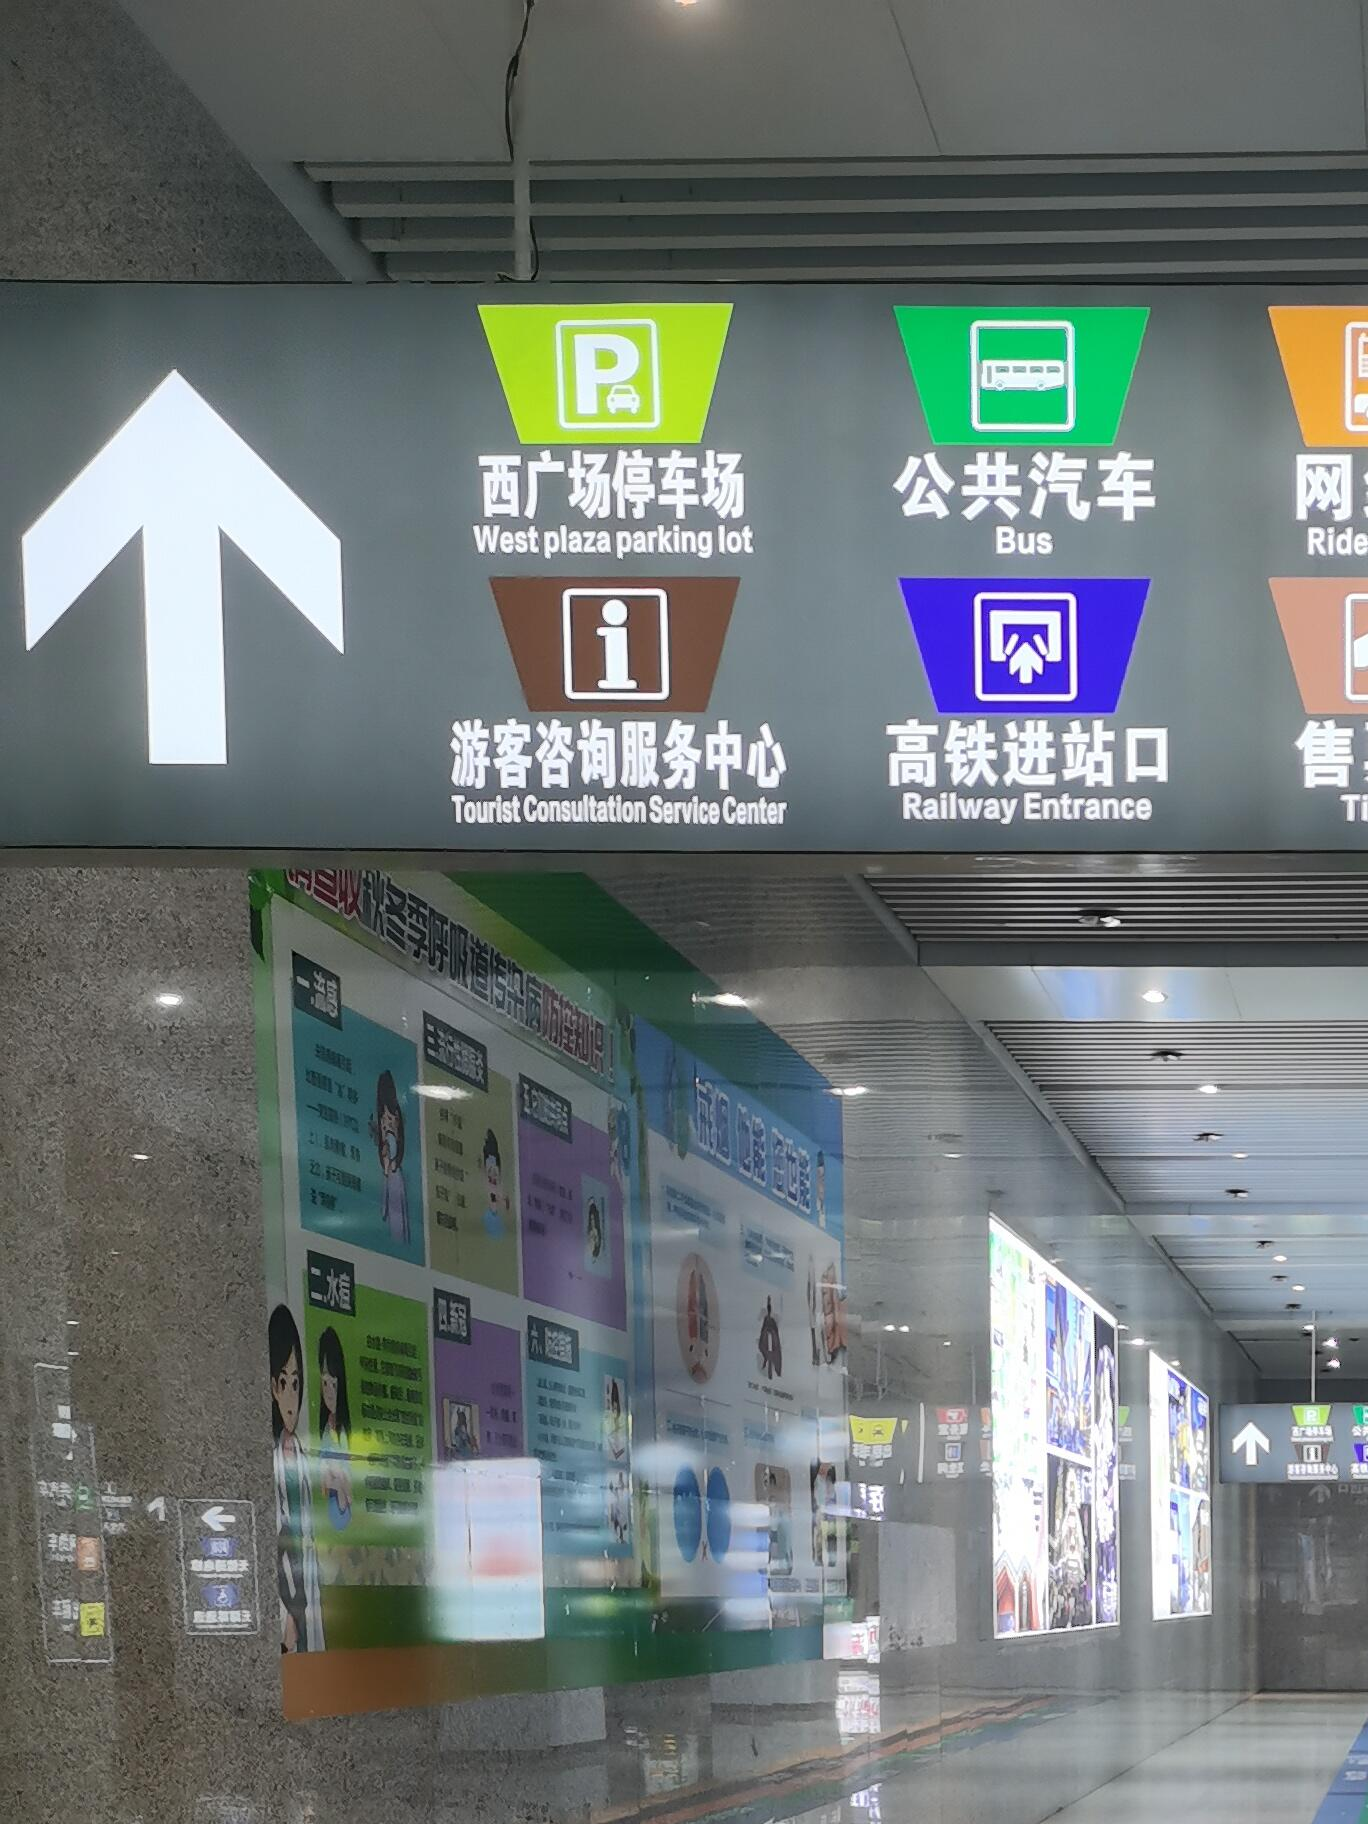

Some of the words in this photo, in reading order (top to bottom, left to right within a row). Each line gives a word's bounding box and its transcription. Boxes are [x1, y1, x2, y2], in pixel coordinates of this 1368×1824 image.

[477, 448, 746, 521] 西广场停车场
[892, 450, 1158, 522] 公共汽车
[473, 524, 540, 555] West
[543, 524, 612, 558] plaza
[615, 524, 713, 559] parking
[717, 524, 754, 555] lot
[995, 525, 1054, 556] Bus
[450, 718, 788, 791] 游客咨询服务中心
[885, 718, 1170, 788] 高铁进站口
[452, 794, 521, 825] Tourist
[524, 794, 647, 825] Consultation
[648, 795, 721, 826] Service
[722, 795, 788, 826] Center
[902, 791, 1020, 826] Railway
[1023, 791, 1154, 822] Entrance
